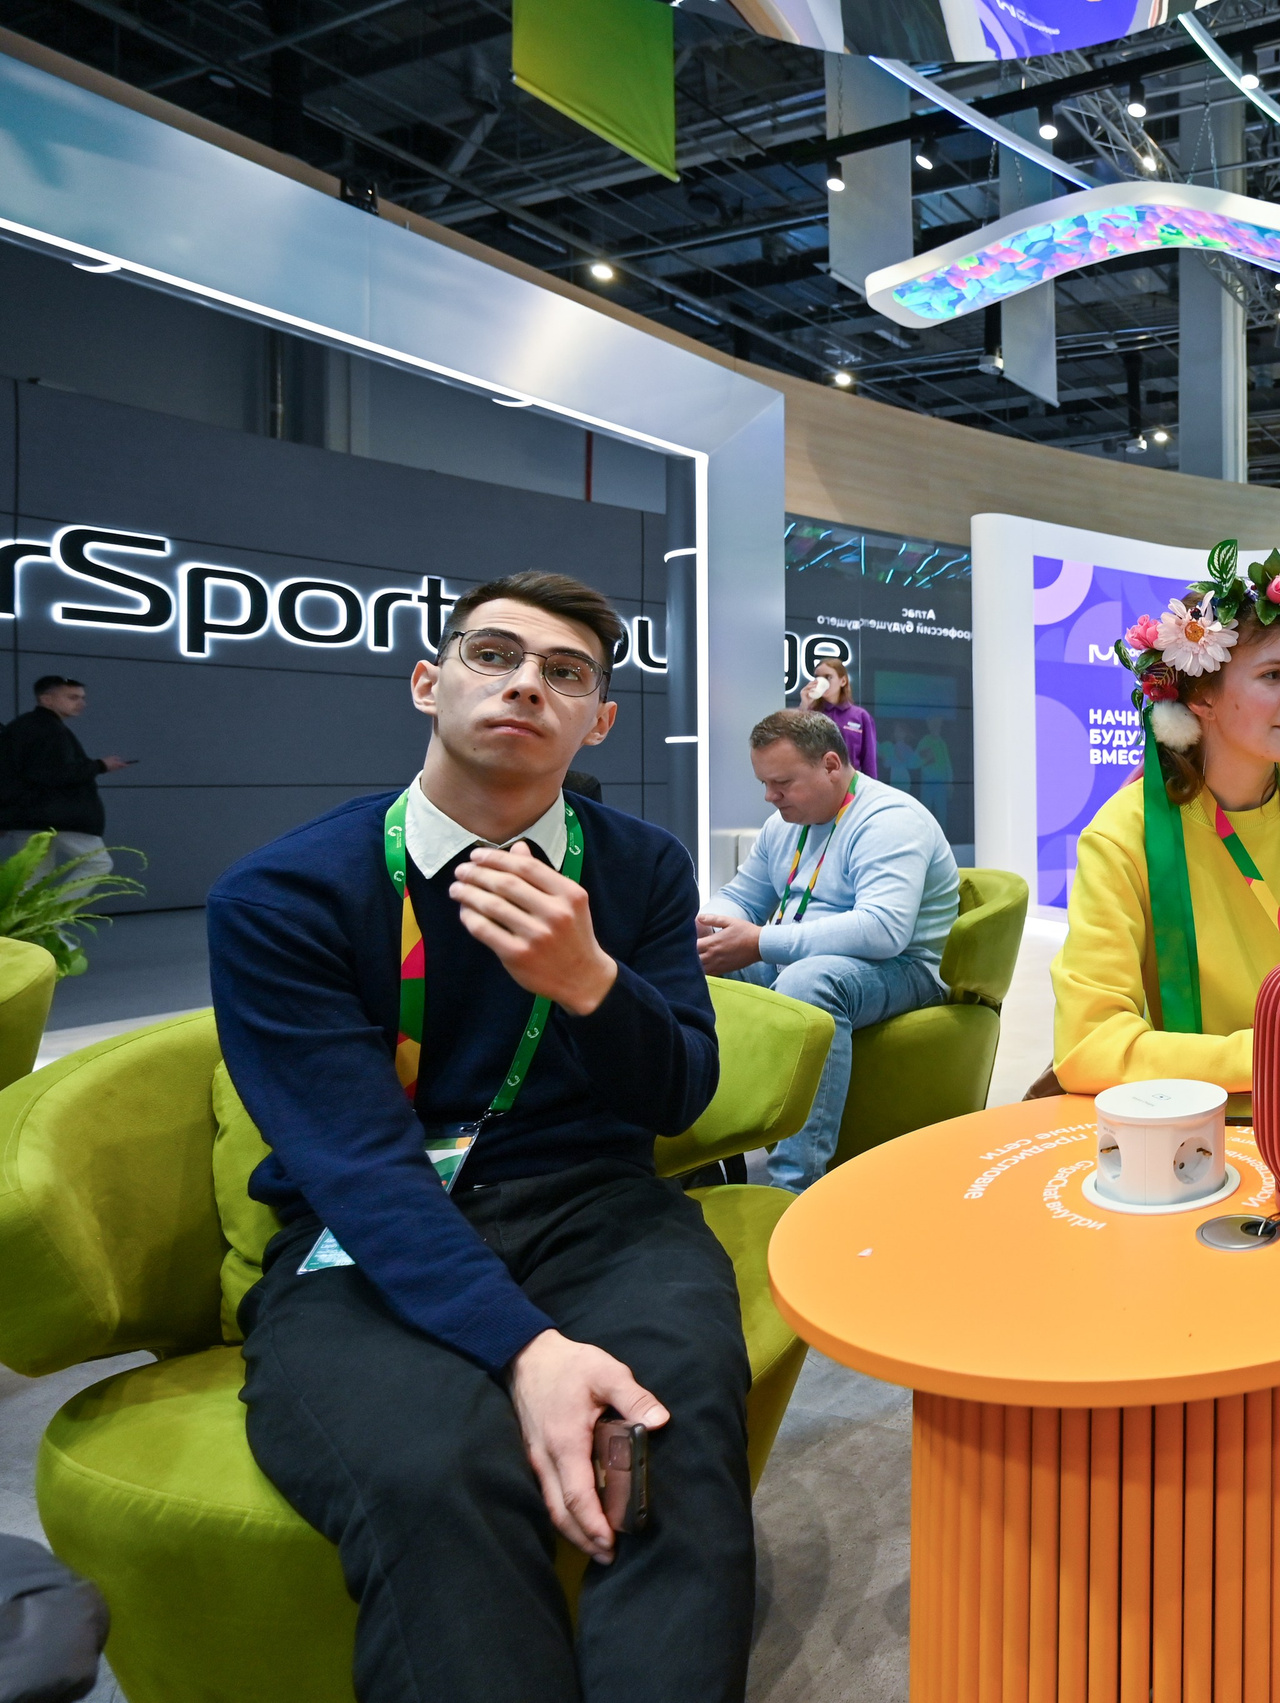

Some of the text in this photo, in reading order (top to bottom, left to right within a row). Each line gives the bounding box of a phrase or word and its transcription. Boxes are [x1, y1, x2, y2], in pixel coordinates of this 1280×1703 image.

[0, 524, 450, 657] rSport
[1089, 708, 1145, 727] НАЧН
[1089, 748, 1144, 766] ВМЕС
[963, 1133, 1089, 1200] предисловие
[979, 1138, 1032, 1161] сети
[1225, 1149, 1276, 1208] Искусственны
[1043, 1160, 1107, 1231] GigaChat внутри
